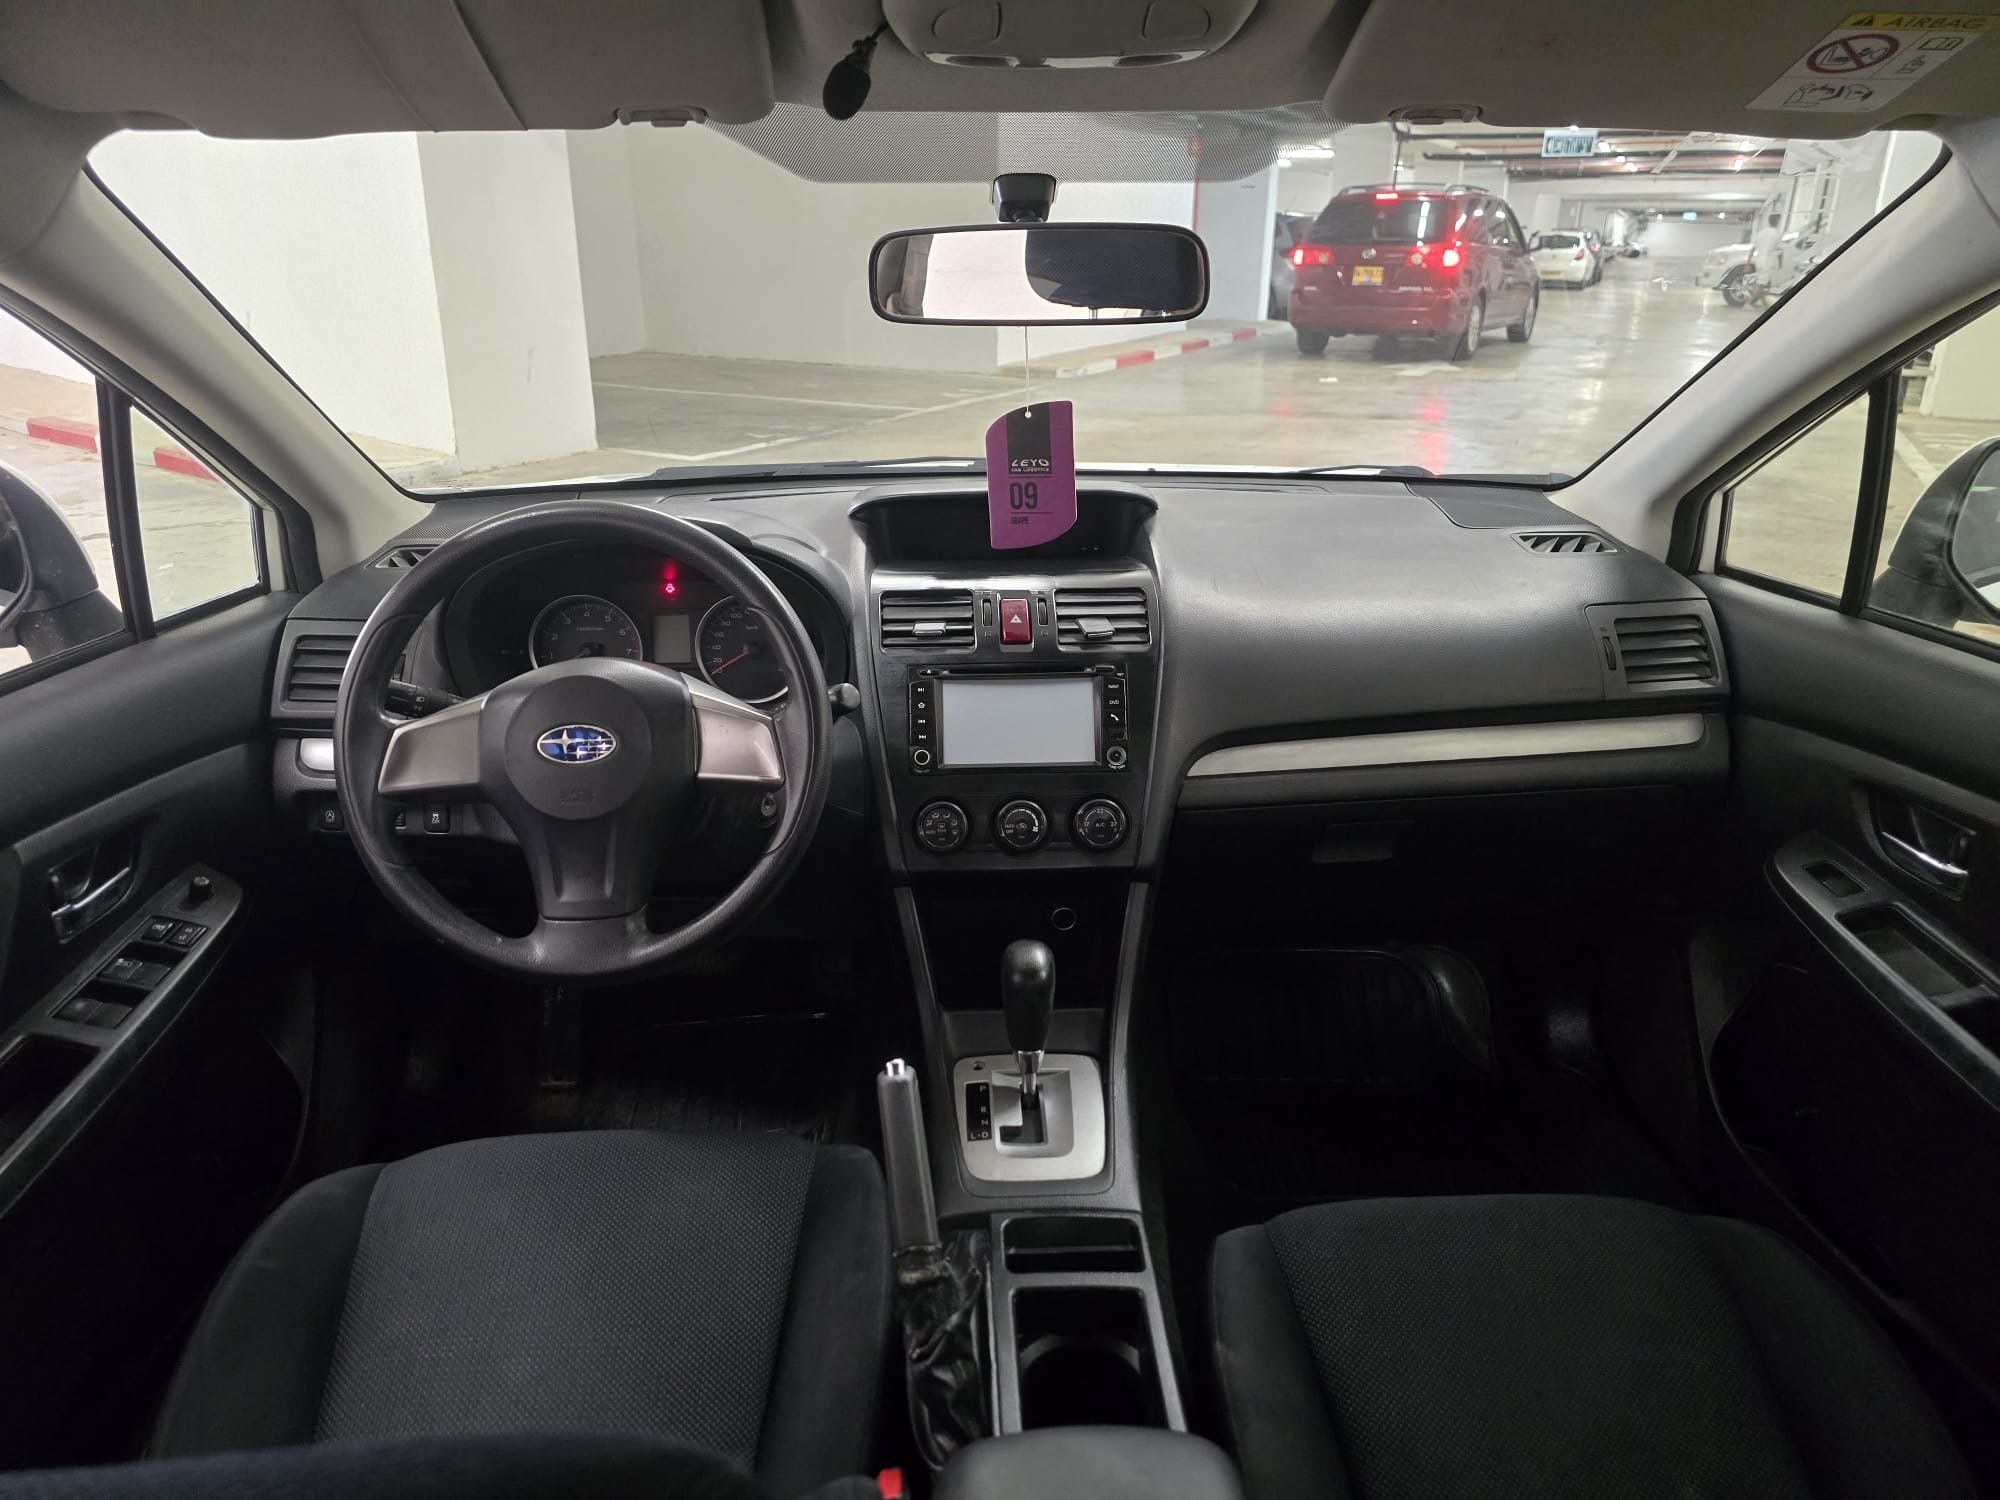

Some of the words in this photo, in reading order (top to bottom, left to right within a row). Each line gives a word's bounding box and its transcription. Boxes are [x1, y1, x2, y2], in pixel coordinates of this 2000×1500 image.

[1883, 15, 1986, 29] AIRBAG
[1011, 458, 1050, 467] LEYO
[1009, 482, 1038, 509] 09
